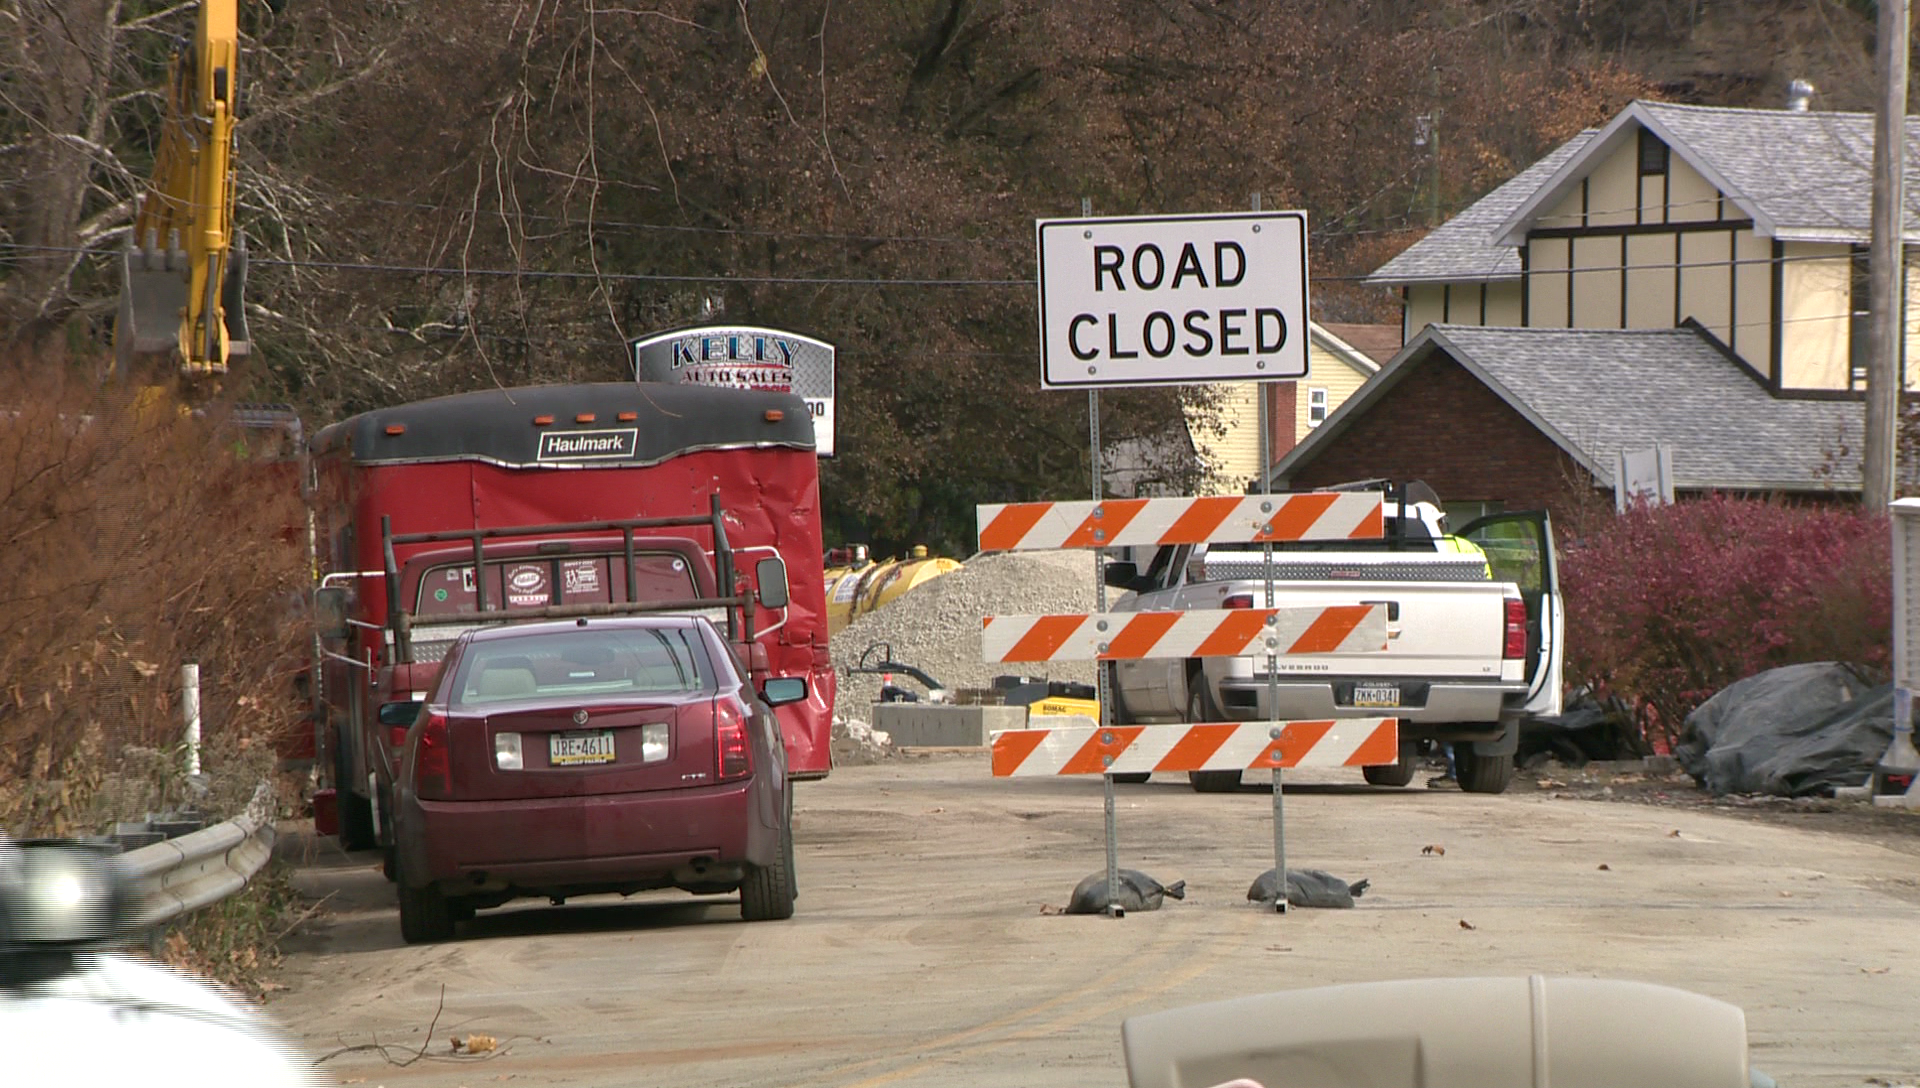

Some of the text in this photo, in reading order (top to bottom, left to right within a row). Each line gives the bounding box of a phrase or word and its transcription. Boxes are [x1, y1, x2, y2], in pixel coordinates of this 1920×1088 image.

[1094, 241, 1247, 292] ROAD
[1068, 308, 1288, 361] CLOSED
[671, 335, 800, 371] KELLY
[682, 371, 793, 383] AUTO SALES
[547, 435, 624, 453] Haulmark
